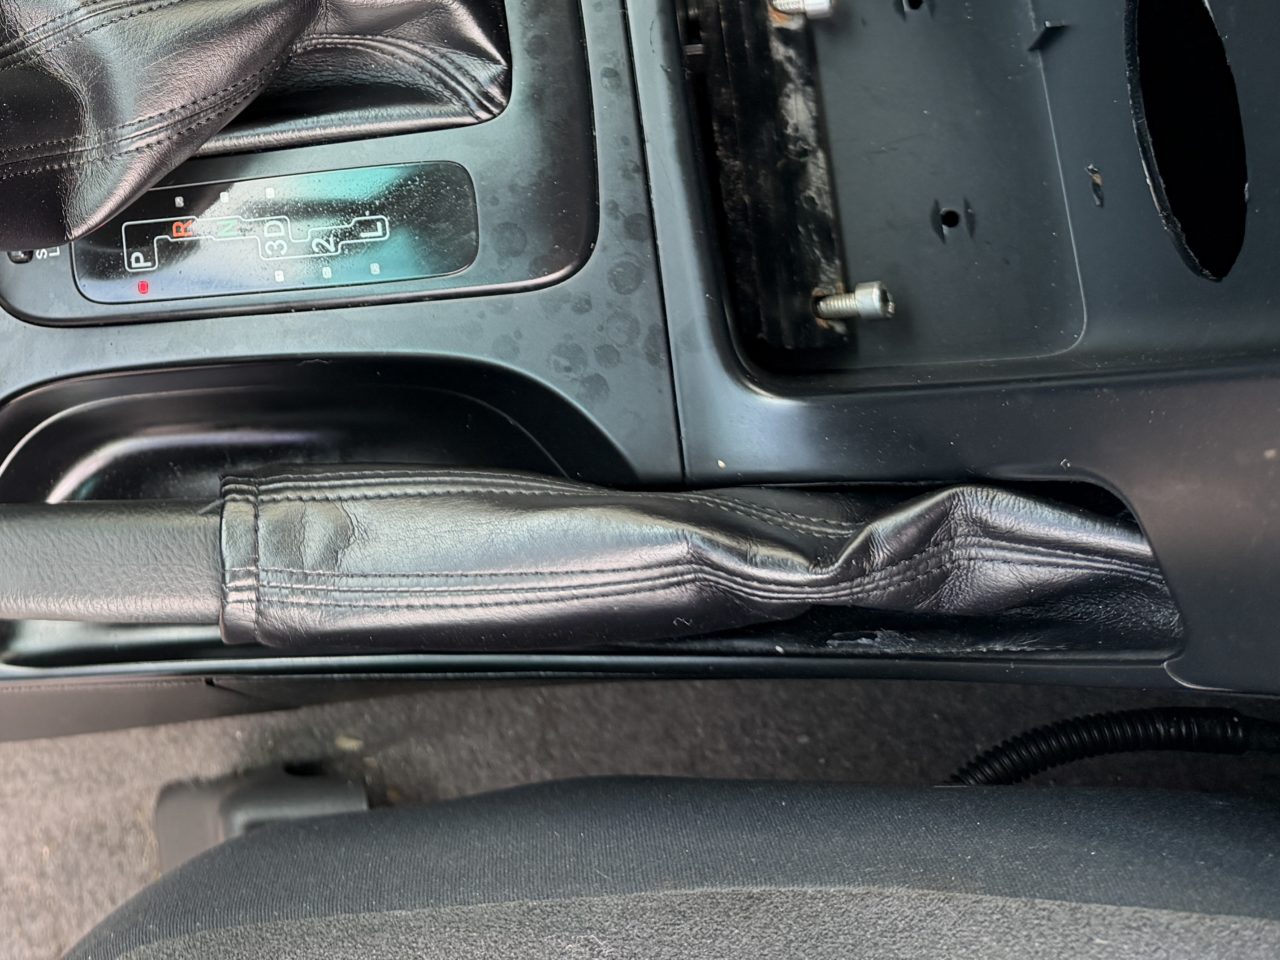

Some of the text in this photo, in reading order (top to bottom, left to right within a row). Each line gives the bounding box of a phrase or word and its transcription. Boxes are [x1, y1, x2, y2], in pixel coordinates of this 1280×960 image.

[172, 219, 194, 238] R
[217, 219, 238, 237] N
[360, 221, 383, 239] L
[312, 237, 337, 254] 2
[130, 250, 152, 269] P
